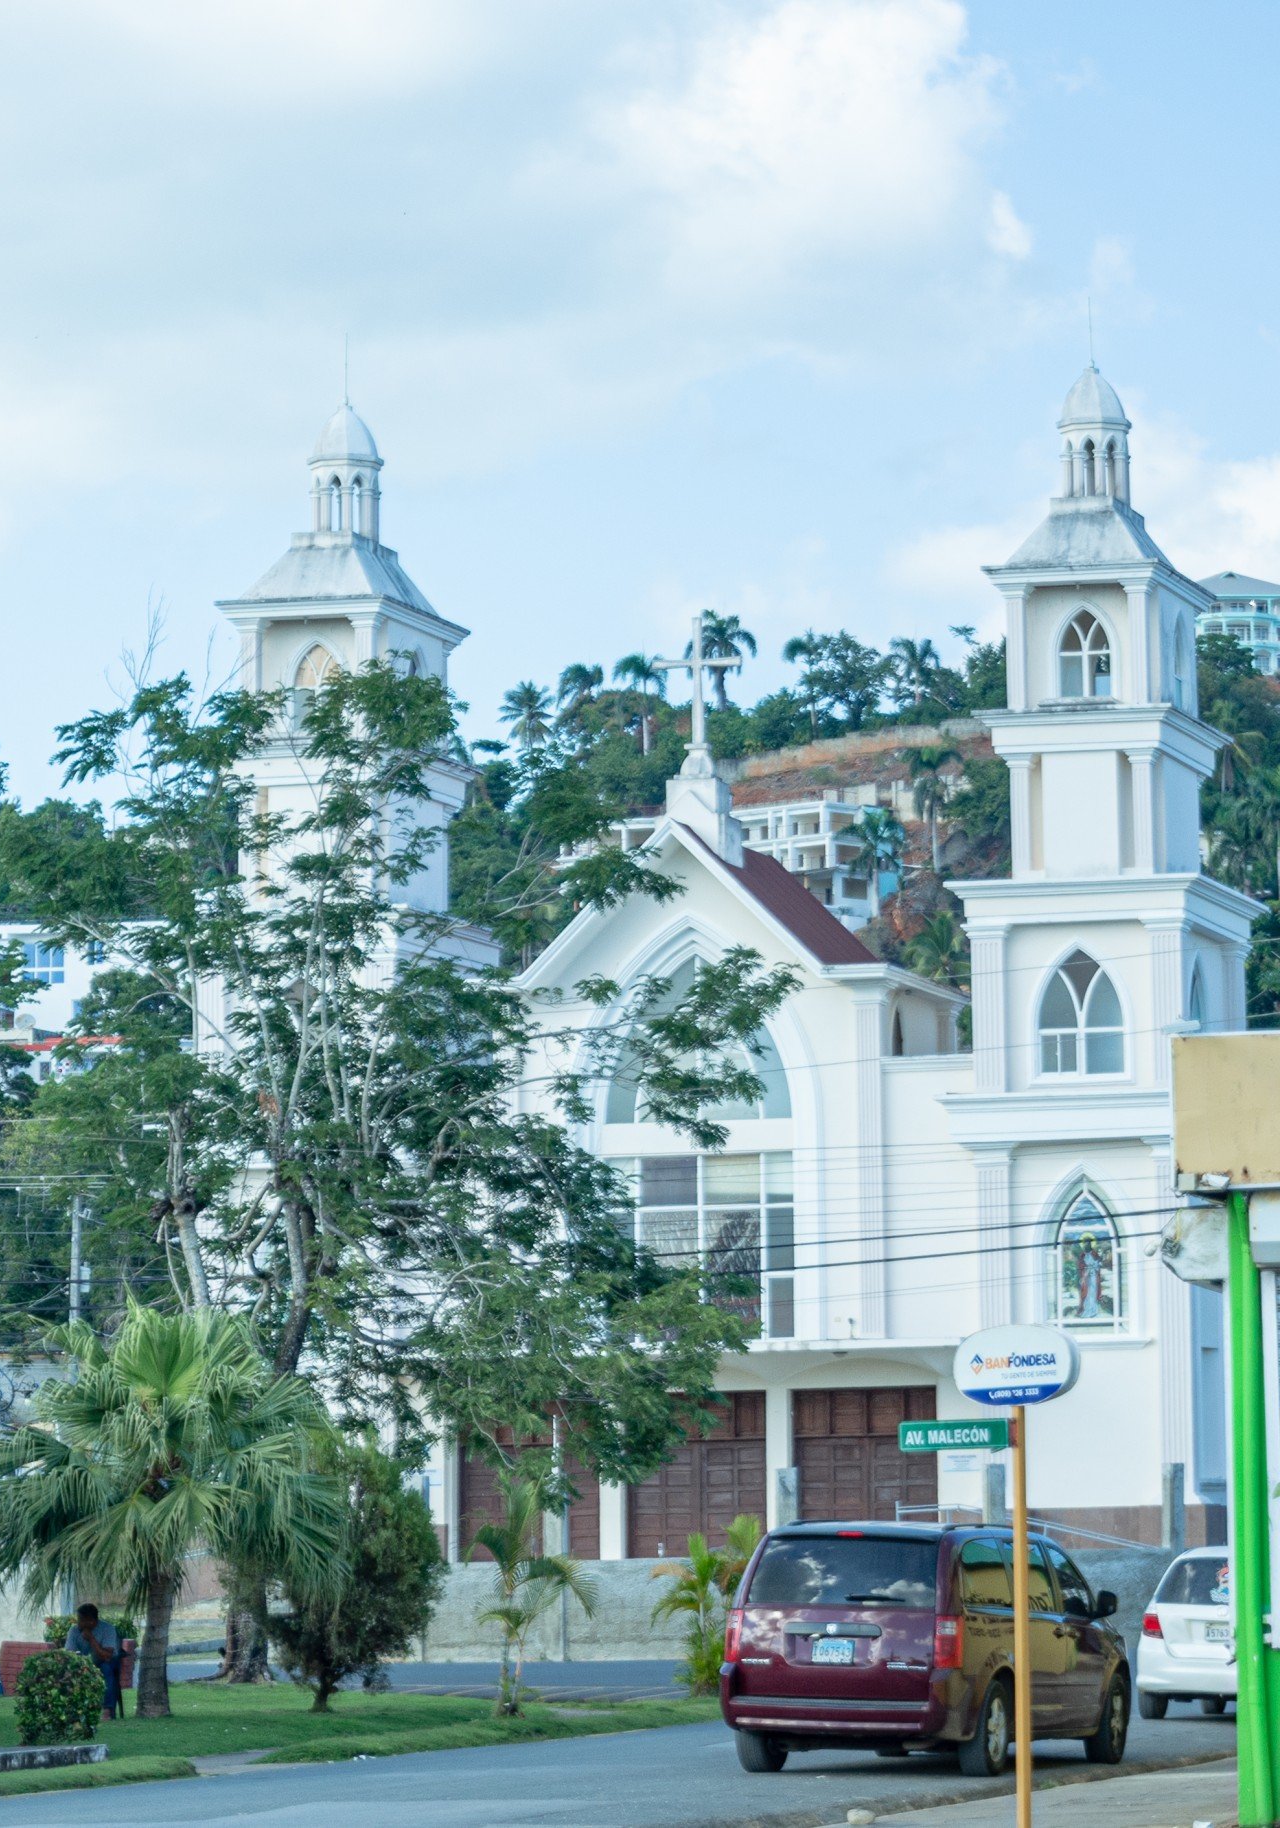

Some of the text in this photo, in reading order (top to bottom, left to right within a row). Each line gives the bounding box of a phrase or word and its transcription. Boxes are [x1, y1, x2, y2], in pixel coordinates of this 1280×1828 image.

[985, 1353, 1056, 1369] BANFONDESA
[905, 1425, 989, 1445] AV. MALECÓN
